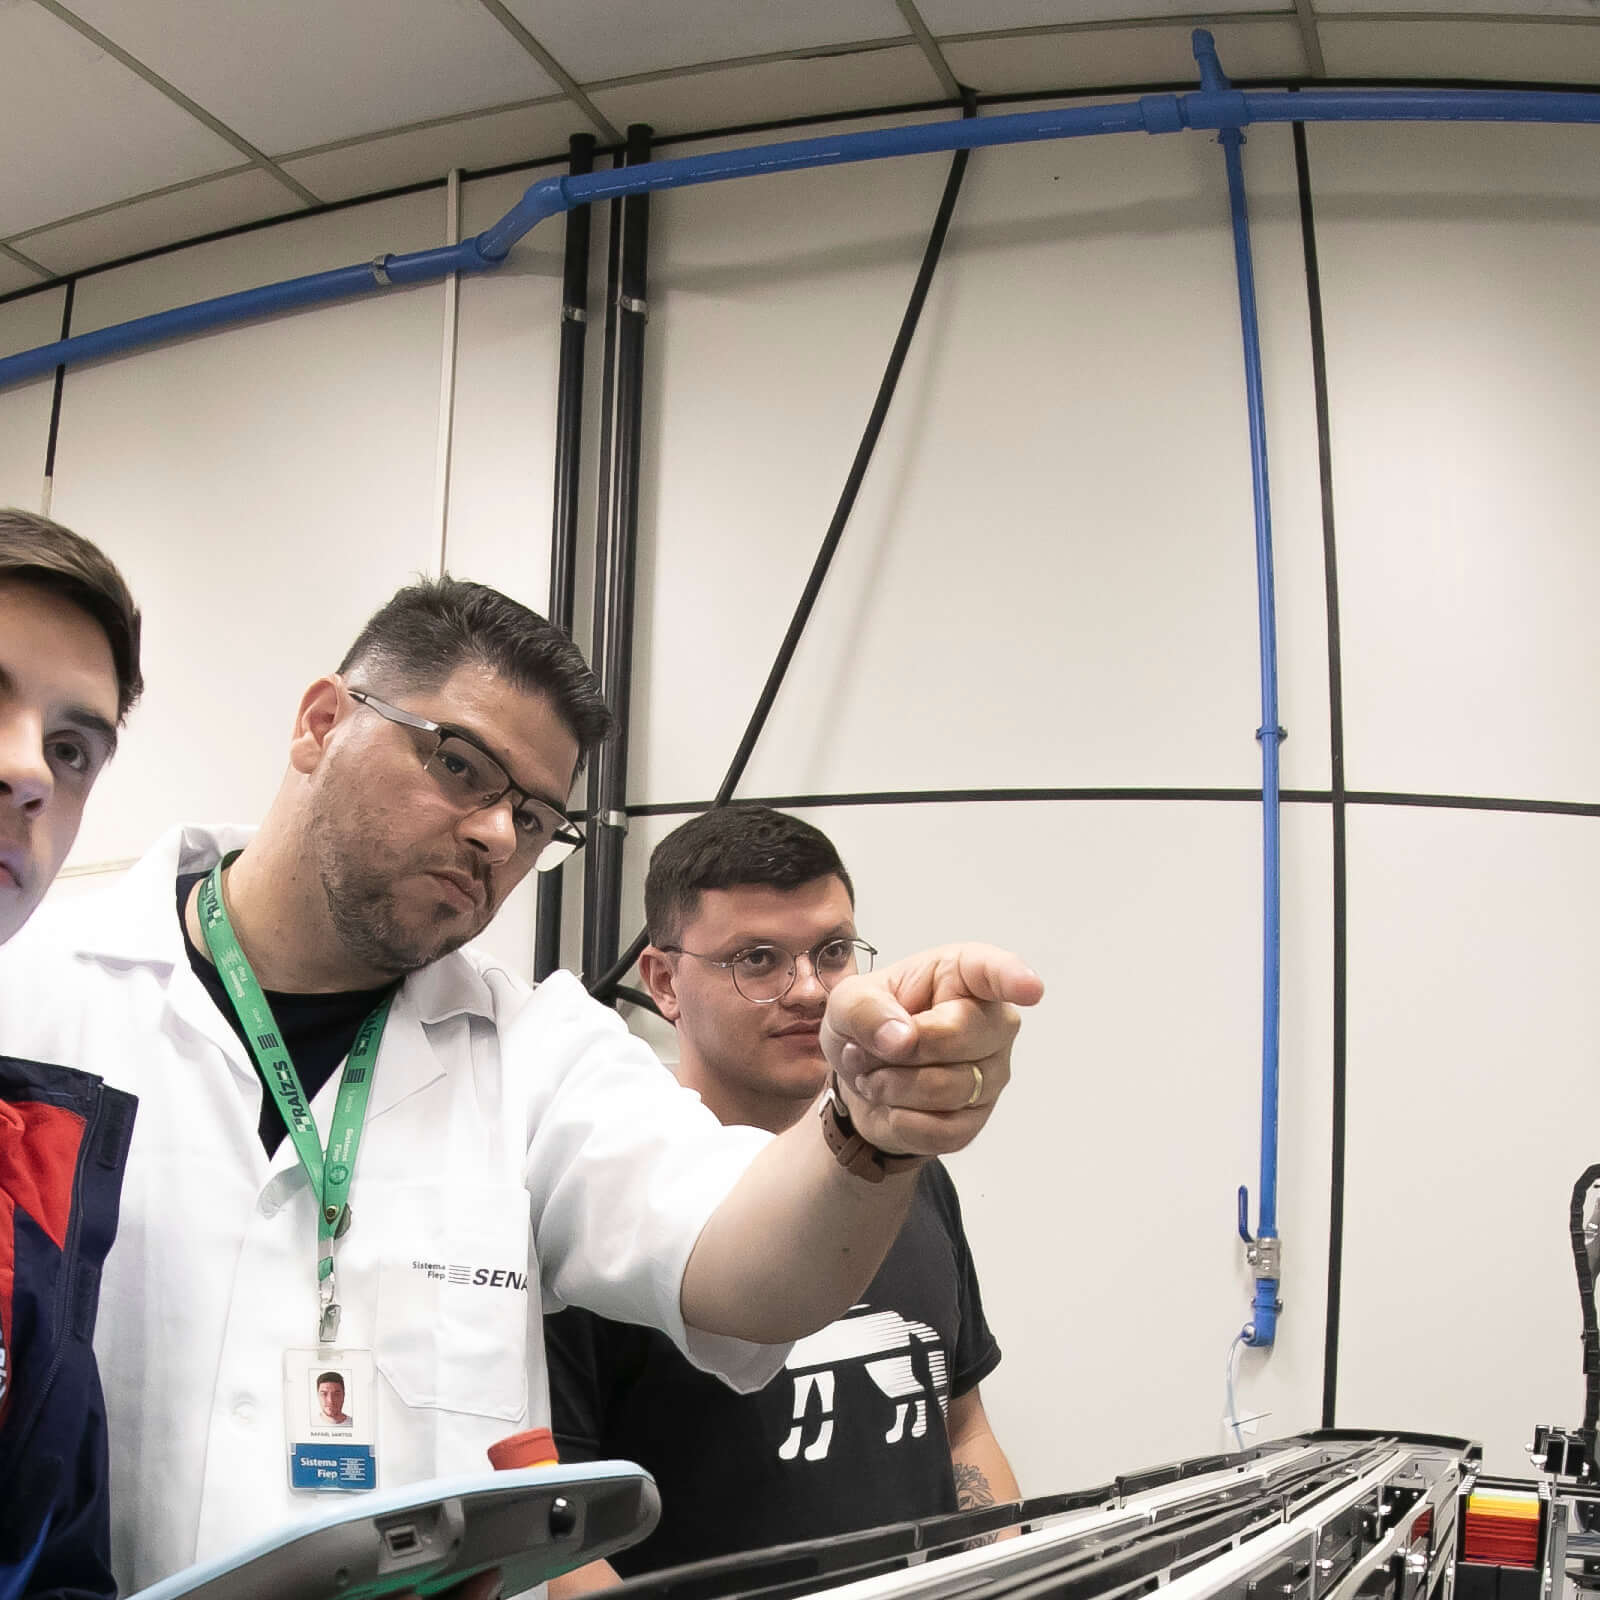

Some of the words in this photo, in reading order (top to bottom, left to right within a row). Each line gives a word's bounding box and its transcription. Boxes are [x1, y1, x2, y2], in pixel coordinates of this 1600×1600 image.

[412, 1260, 446, 1270] Sistema
[427, 1270, 446, 1281] Fiep
[300, 1457, 338, 1467] Sistema
[317, 1468, 338, 1480] Fiep
